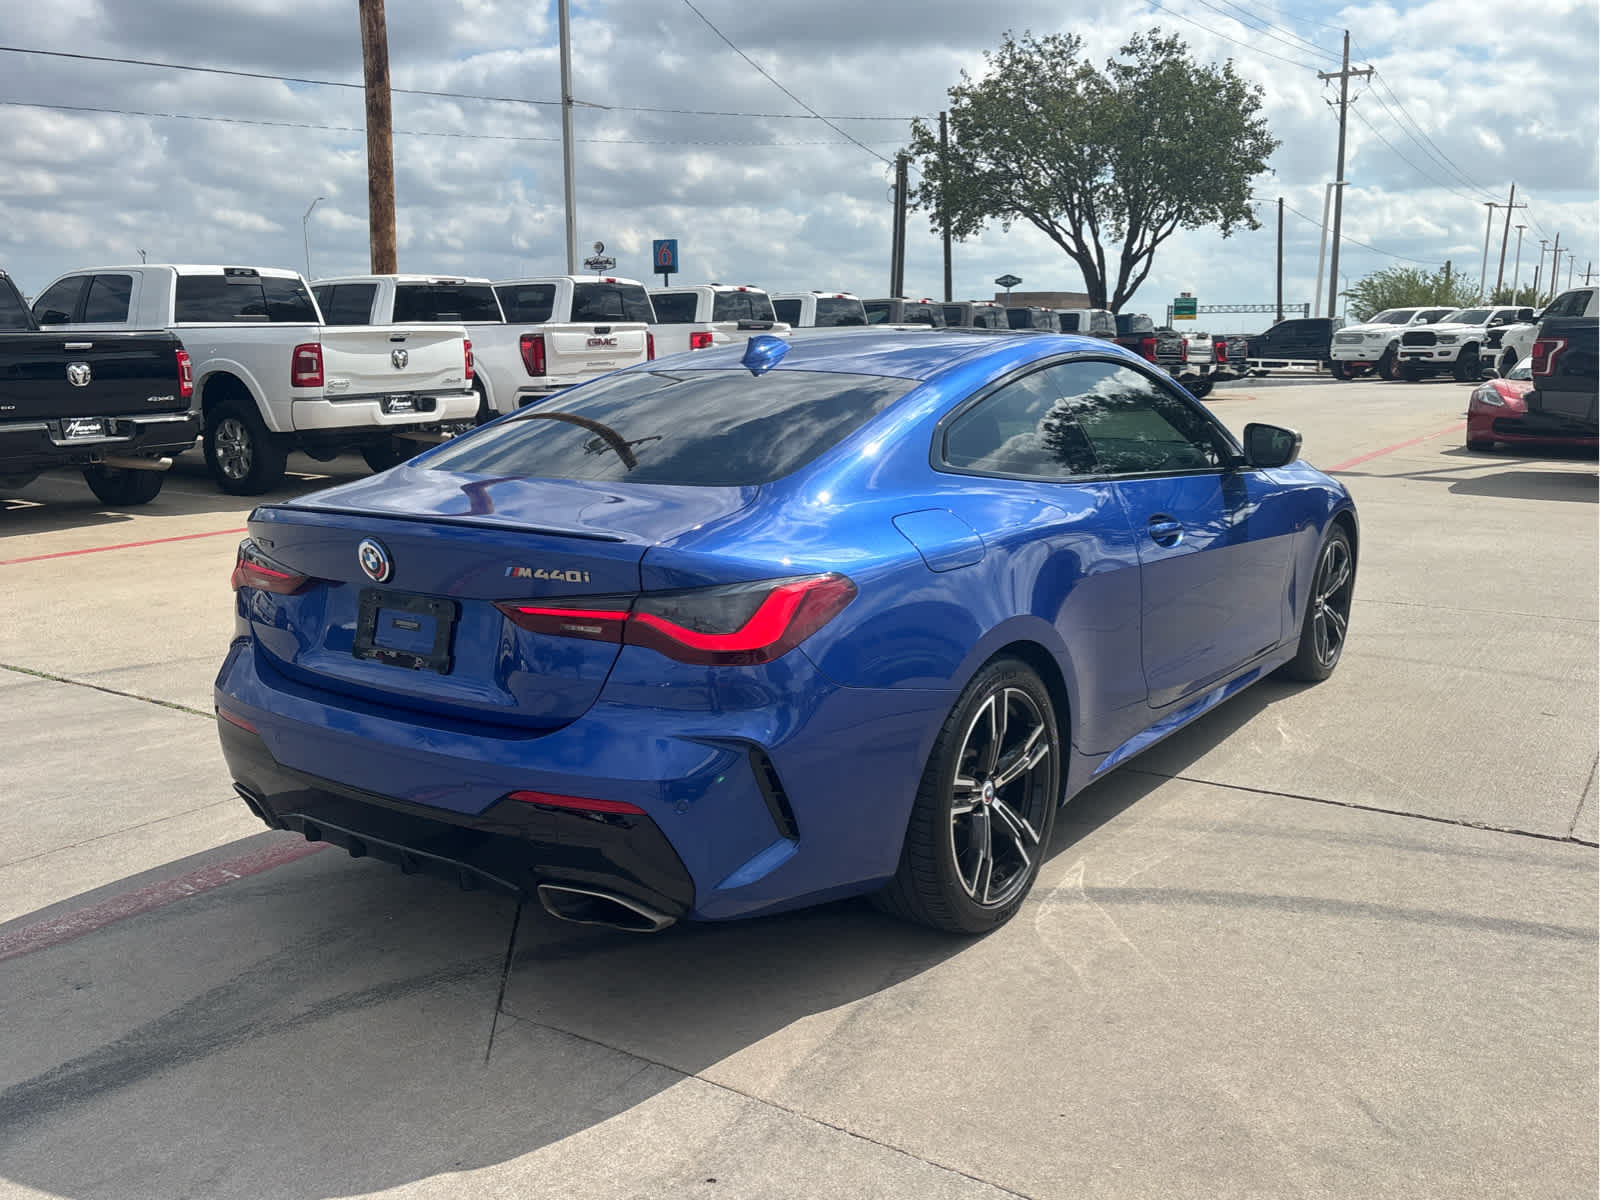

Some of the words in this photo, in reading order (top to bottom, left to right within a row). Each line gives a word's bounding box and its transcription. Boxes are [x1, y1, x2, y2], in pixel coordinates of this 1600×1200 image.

[657, 242, 672, 266] 6
[587, 337, 618, 347] GMC
[518, 567, 591, 584] M440i
